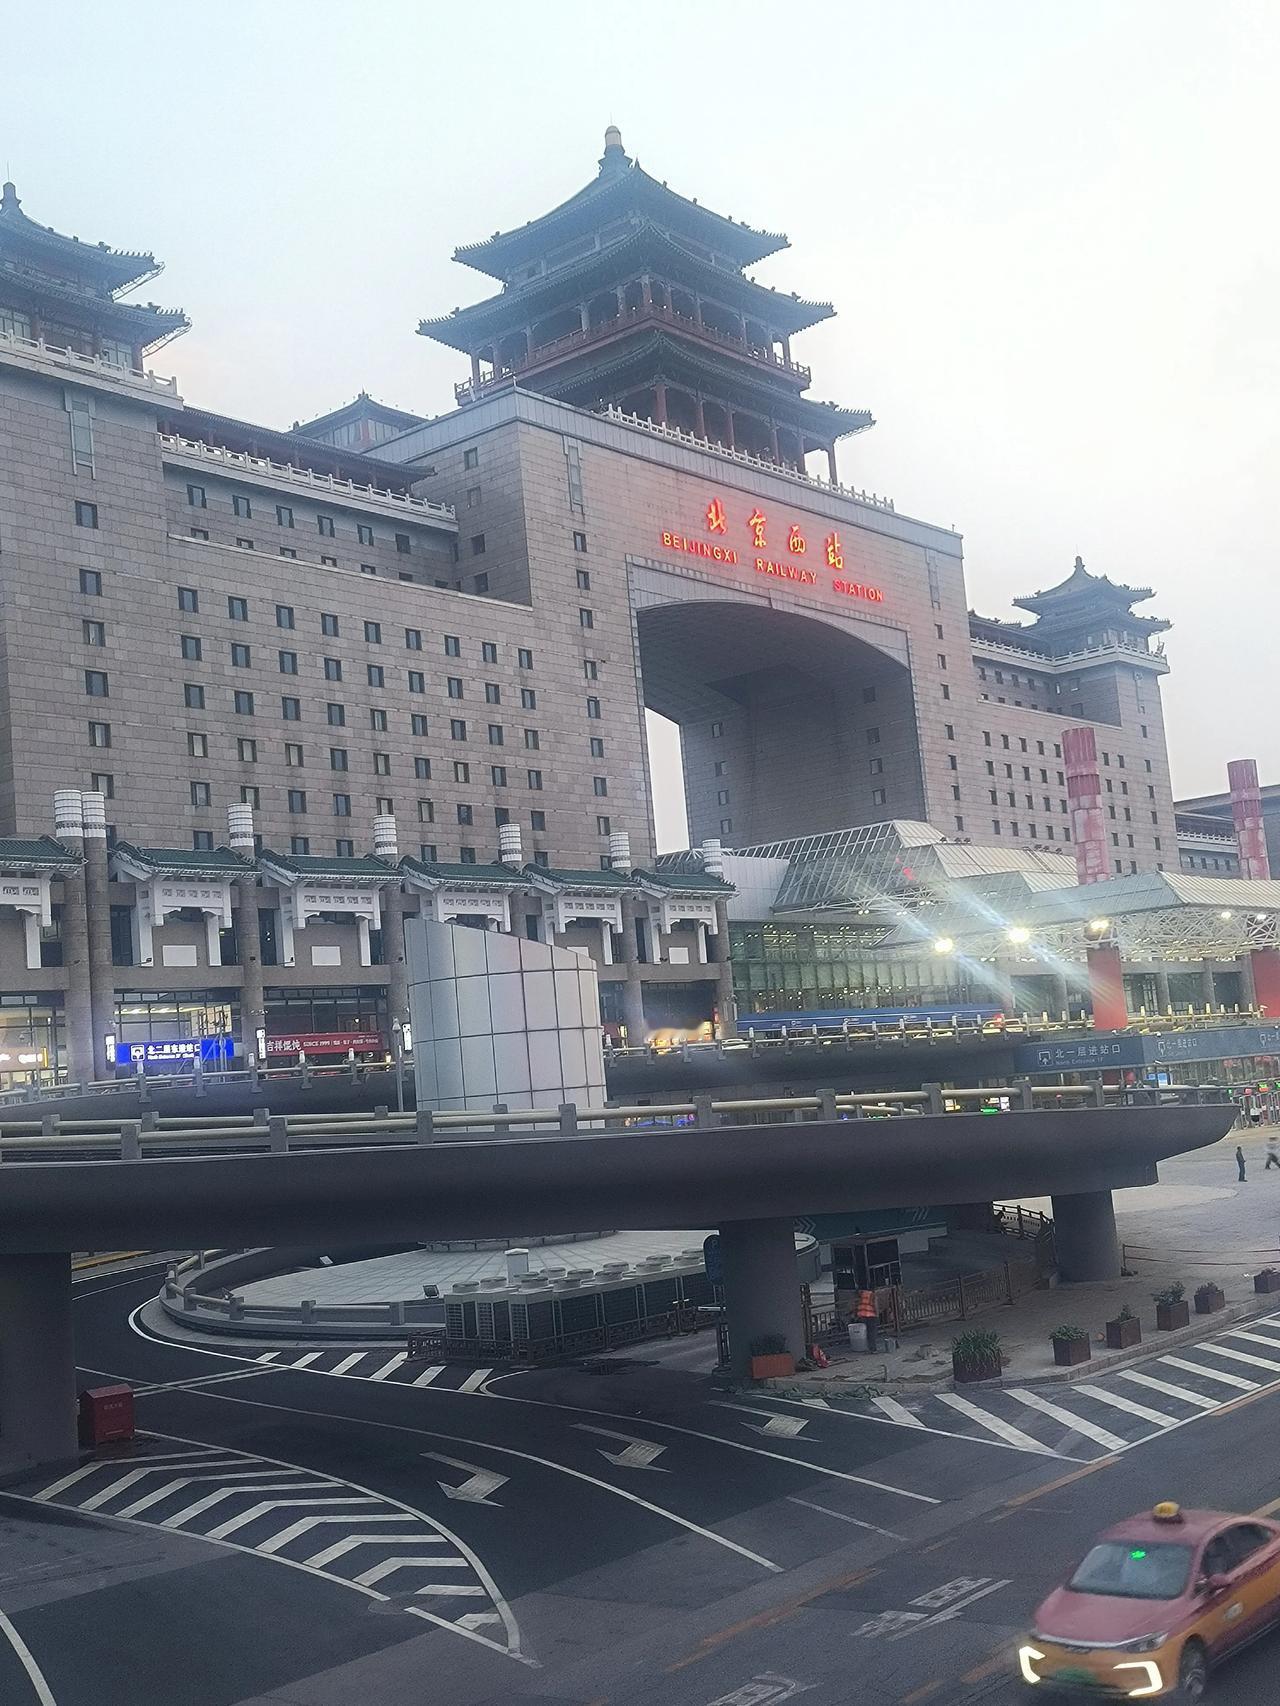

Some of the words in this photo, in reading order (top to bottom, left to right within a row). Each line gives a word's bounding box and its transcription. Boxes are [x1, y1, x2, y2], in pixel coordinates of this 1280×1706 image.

[707, 497, 844, 569] 北京西站
[662, 531, 738, 564] BEIJINGXI
[755, 558, 817, 584] RAILWAY
[833, 579, 884, 602] STATION
[266, 1039, 302, 1052] 吉祥馄饨
[1055, 1044, 1121, 1059] 北一层进站口
